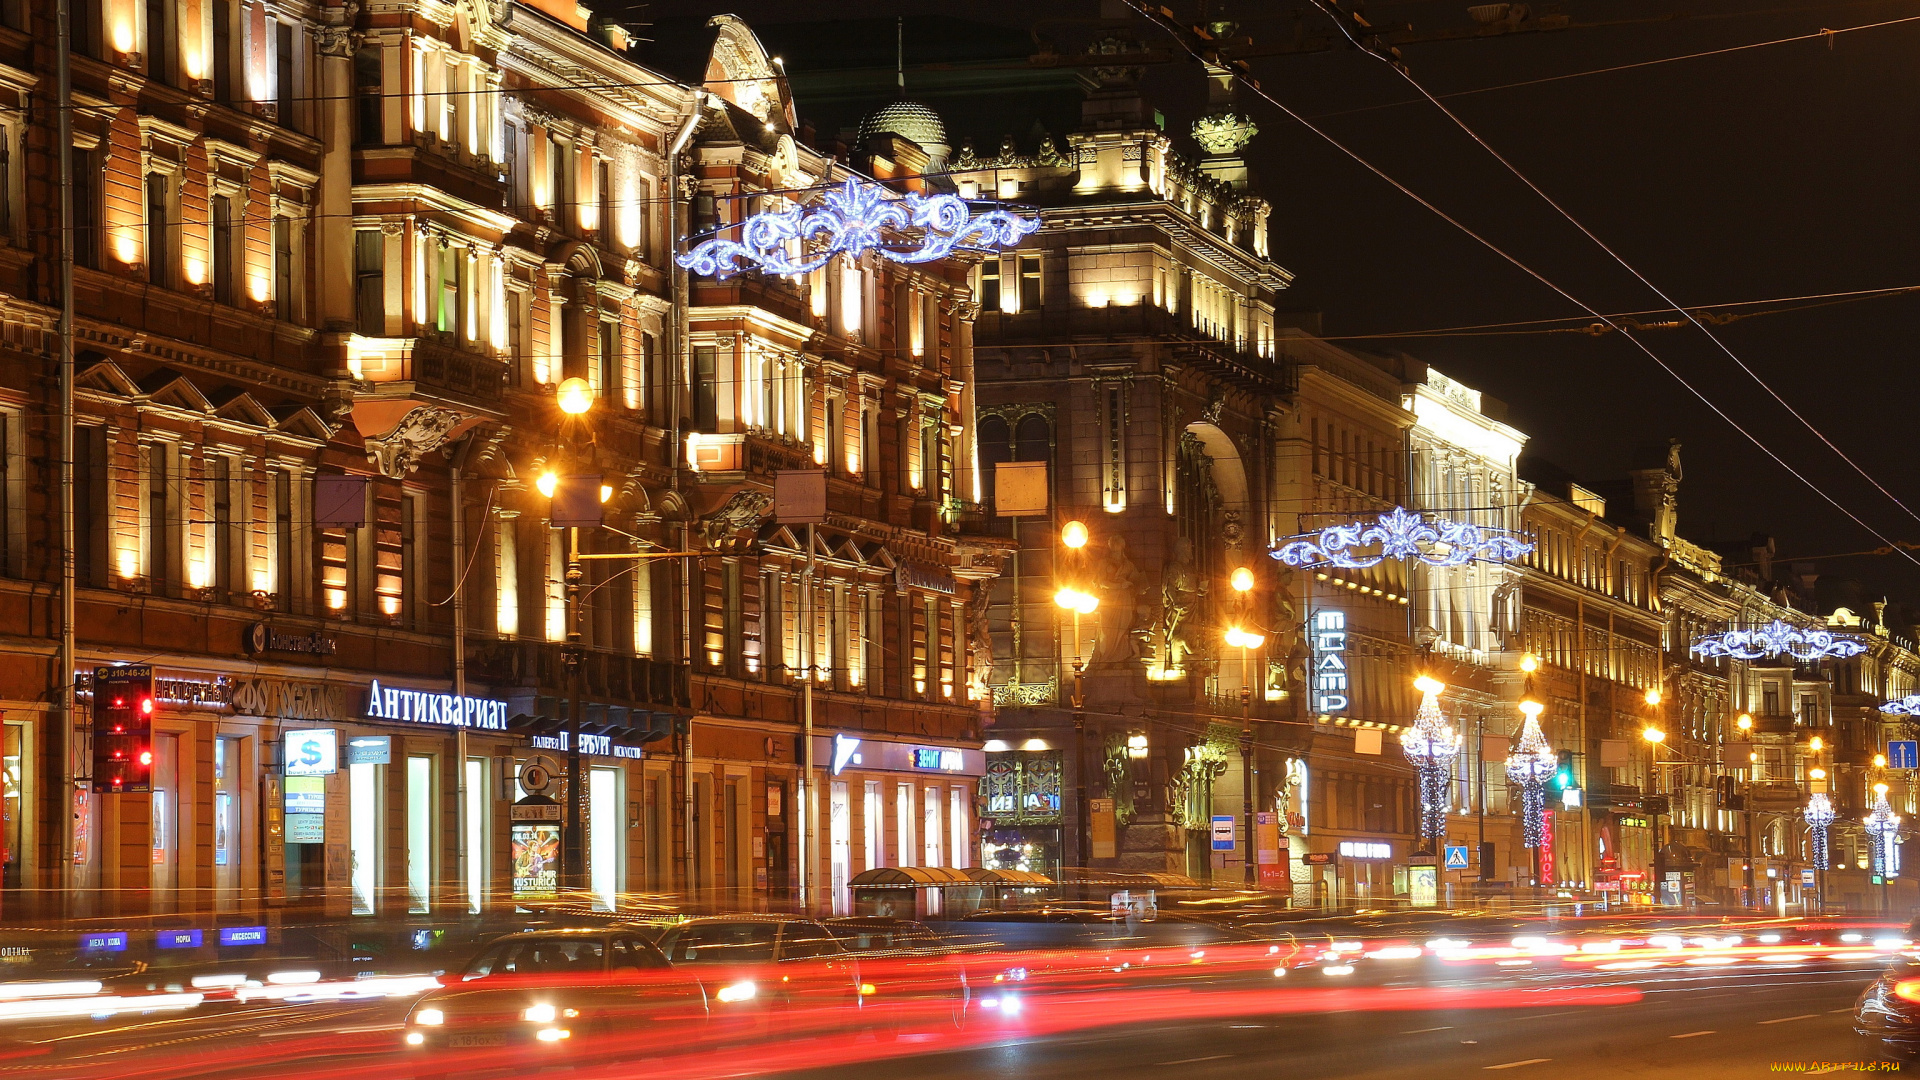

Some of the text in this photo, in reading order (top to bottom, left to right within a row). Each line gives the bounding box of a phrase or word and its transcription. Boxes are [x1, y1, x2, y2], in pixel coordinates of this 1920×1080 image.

[111, 669, 150, 677] 310-46-24
[531, 731, 641, 759] ГАЛЕРЕЯ ПЕРБУРГ ИСКУССТВ
[918, 749, 939, 768] ЗЕНИТ
[538, 870, 557, 878] EMIR
[1263, 870, 1285, 878] 1+1=2
[513, 878, 557, 887] KUSTURICA
[89, 937, 121, 947] МЕХА КОЖА
[175, 935, 191, 944] НОРКА
[1, 947, 30, 956] ОПТИКА
